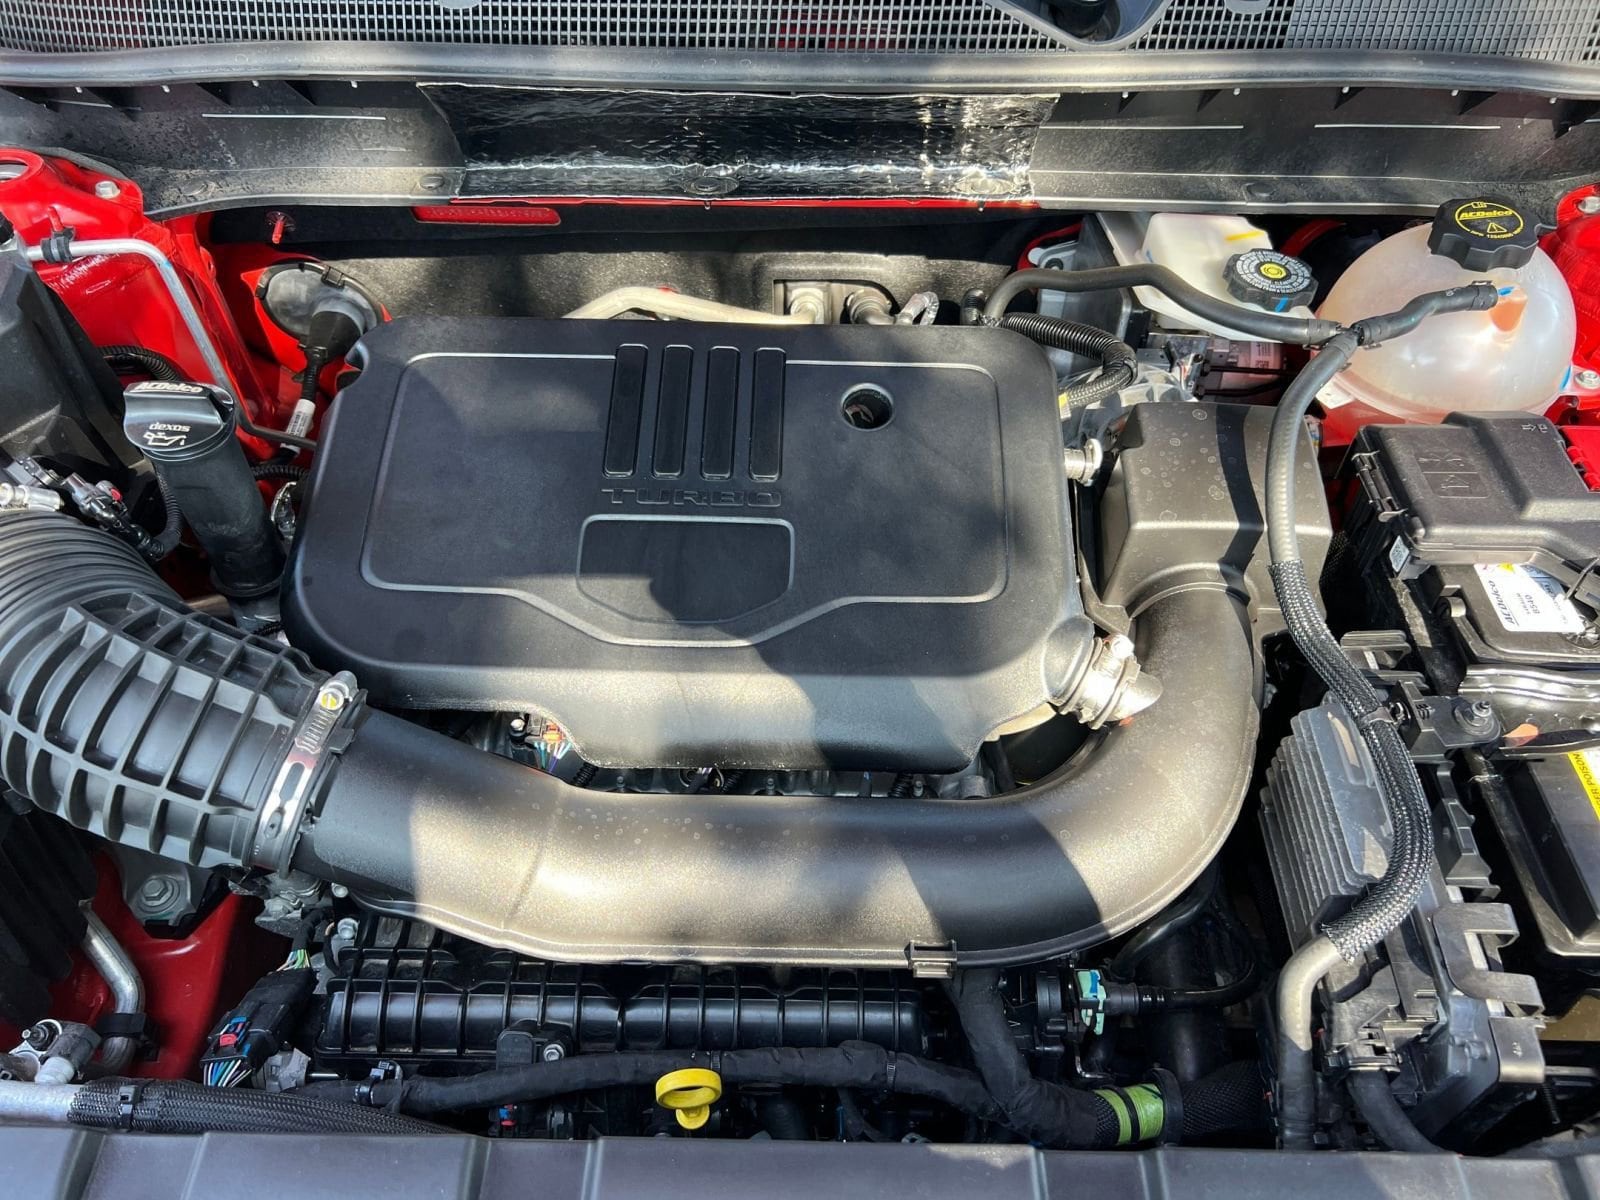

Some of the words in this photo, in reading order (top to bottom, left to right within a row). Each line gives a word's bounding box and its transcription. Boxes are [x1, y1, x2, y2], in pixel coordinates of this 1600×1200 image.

[1460, 209, 1513, 218] ACDelco
[133, 382, 203, 393] ACDelco
[148, 422, 191, 432] dexos
[600, 488, 781, 507] TURBO
[1488, 580, 1515, 625] ACDelco
[1573, 752, 1597, 786] POISON
